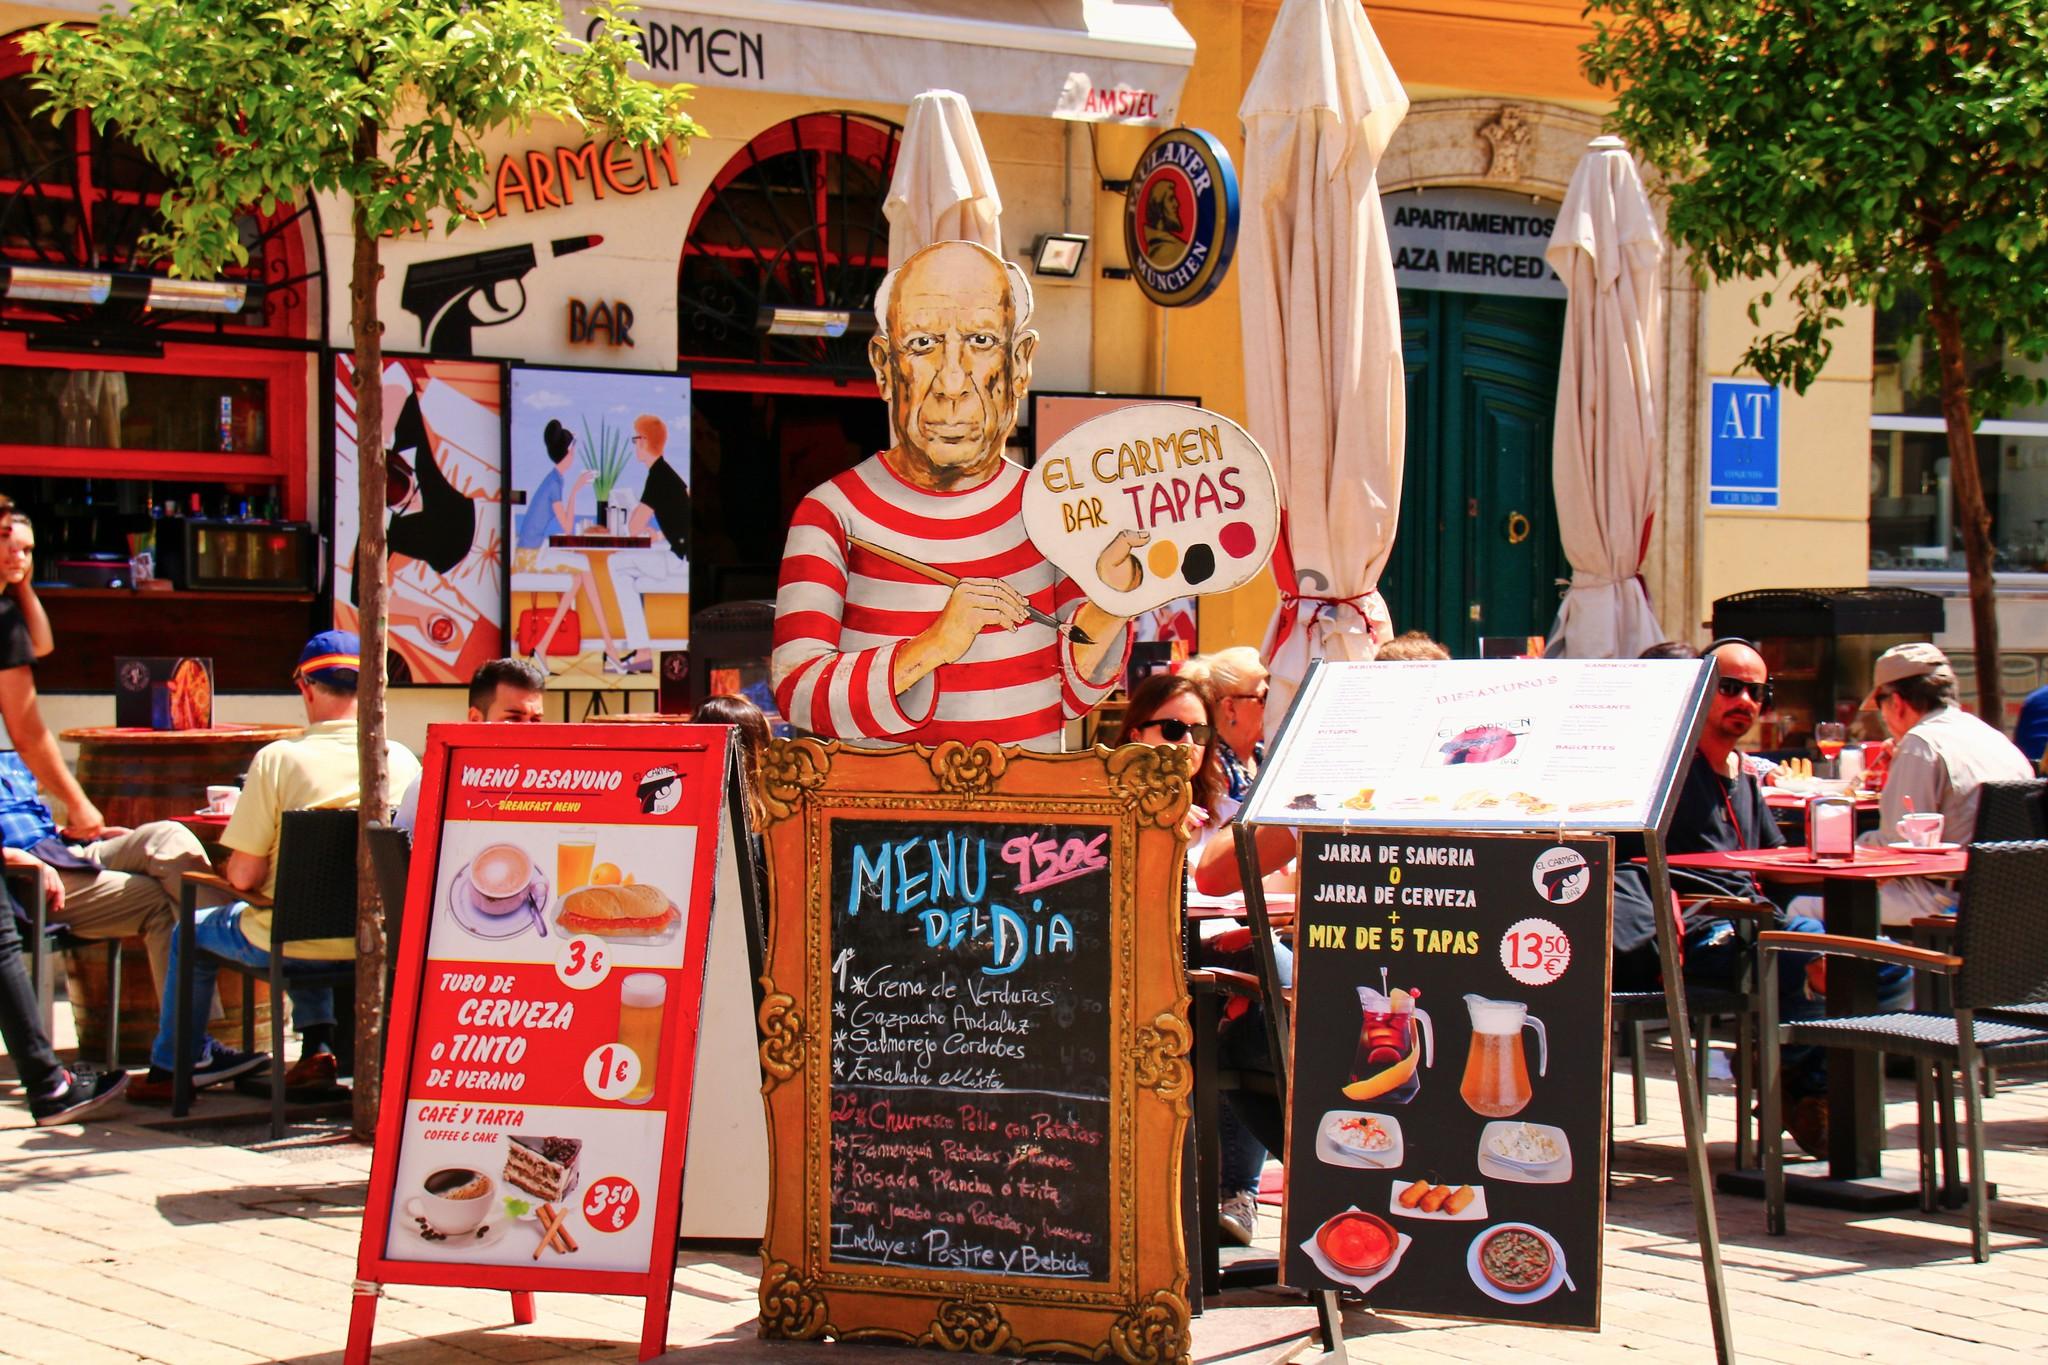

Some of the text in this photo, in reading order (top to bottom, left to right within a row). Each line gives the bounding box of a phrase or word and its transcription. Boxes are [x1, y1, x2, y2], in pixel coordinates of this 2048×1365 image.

[1085, 87, 1158, 118] AMSTEL
[1394, 207, 1556, 238] APARTAMENTOS
[1393, 247, 1440, 272] AZA
[1447, 250, 1544, 279] MERCED
[568, 297, 635, 347] BAR
[1719, 392, 1771, 440] AT
[1042, 425, 1224, 493] EL CARMEN
[1061, 466, 1246, 533] BAR TAPAS
[461, 764, 622, 790] MENÚ DESAYUNO
[498, 800, 582, 812] BREAKFAST MENU
[1318, 843, 1475, 866] JARRA DE SANGRIA
[1548, 854, 1579, 868] CARMEN
[848, 831, 987, 916] MENU
[1389, 867, 1401, 884] O
[1314, 884, 1477, 908] JARRA DE CERVEZA
[1564, 887, 1581, 900] BAR
[918, 907, 987, 949] DEL
[1309, 925, 1480, 954] MIX DE 5 TAPAS
[440, 973, 515, 994] TUBO DE
[932, 972, 957, 998] de
[967, 977, 1054, 1006] Verduras
[457, 998, 575, 1030] CERVEZA
[851, 1001, 1031, 1035] Gazpacho Andaluz
[448, 1034, 527, 1065] TINTO
[944, 1033, 1025, 1059] Cordobes
[426, 1070, 526, 1092] DE VERANO
[848, 1057, 932, 1085] Ensalada
[418, 1103, 525, 1126] CAFÉ Y TARTA
[958, 1104, 998, 1132] Pollo
[1005, 1122, 1030, 1138] con
[424, 1130, 499, 1143] COFFEE & CAKE
[941, 1139, 1001, 1164] Patatas
[852, 1160, 919, 1189] Rosada
[928, 1166, 994, 1197] Plancha
[843, 1191, 880, 1215] San
[938, 1212, 965, 1224] con
[1024, 1225, 1036, 1241] y
[831, 1224, 916, 1266] Incluye:
[923, 1229, 994, 1267] Postre
[1021, 1246, 1091, 1274] Bebida
